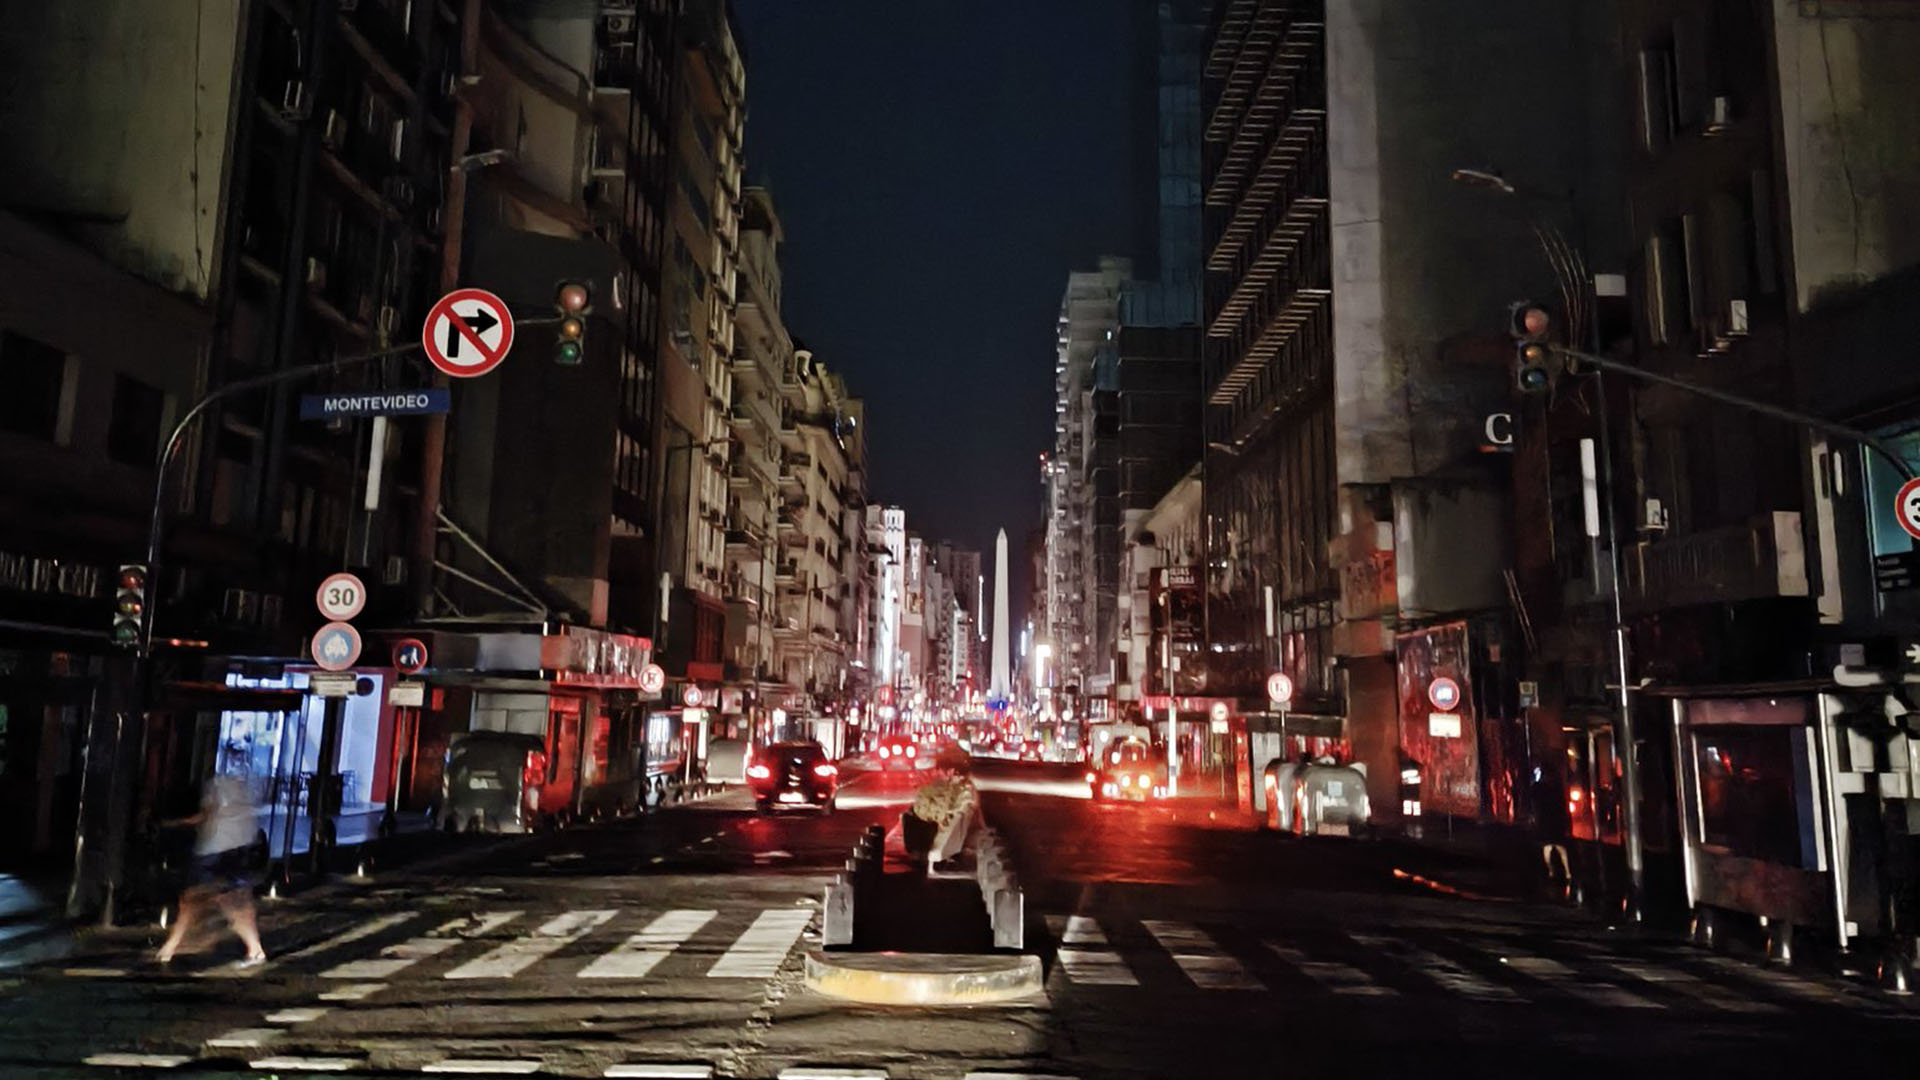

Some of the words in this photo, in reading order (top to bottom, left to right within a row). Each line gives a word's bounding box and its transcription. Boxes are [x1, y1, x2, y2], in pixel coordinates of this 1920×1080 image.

[323, 394, 429, 413] MONTEVIDEO
[1485, 413, 1512, 444] C
[328, 587, 354, 606] 30
